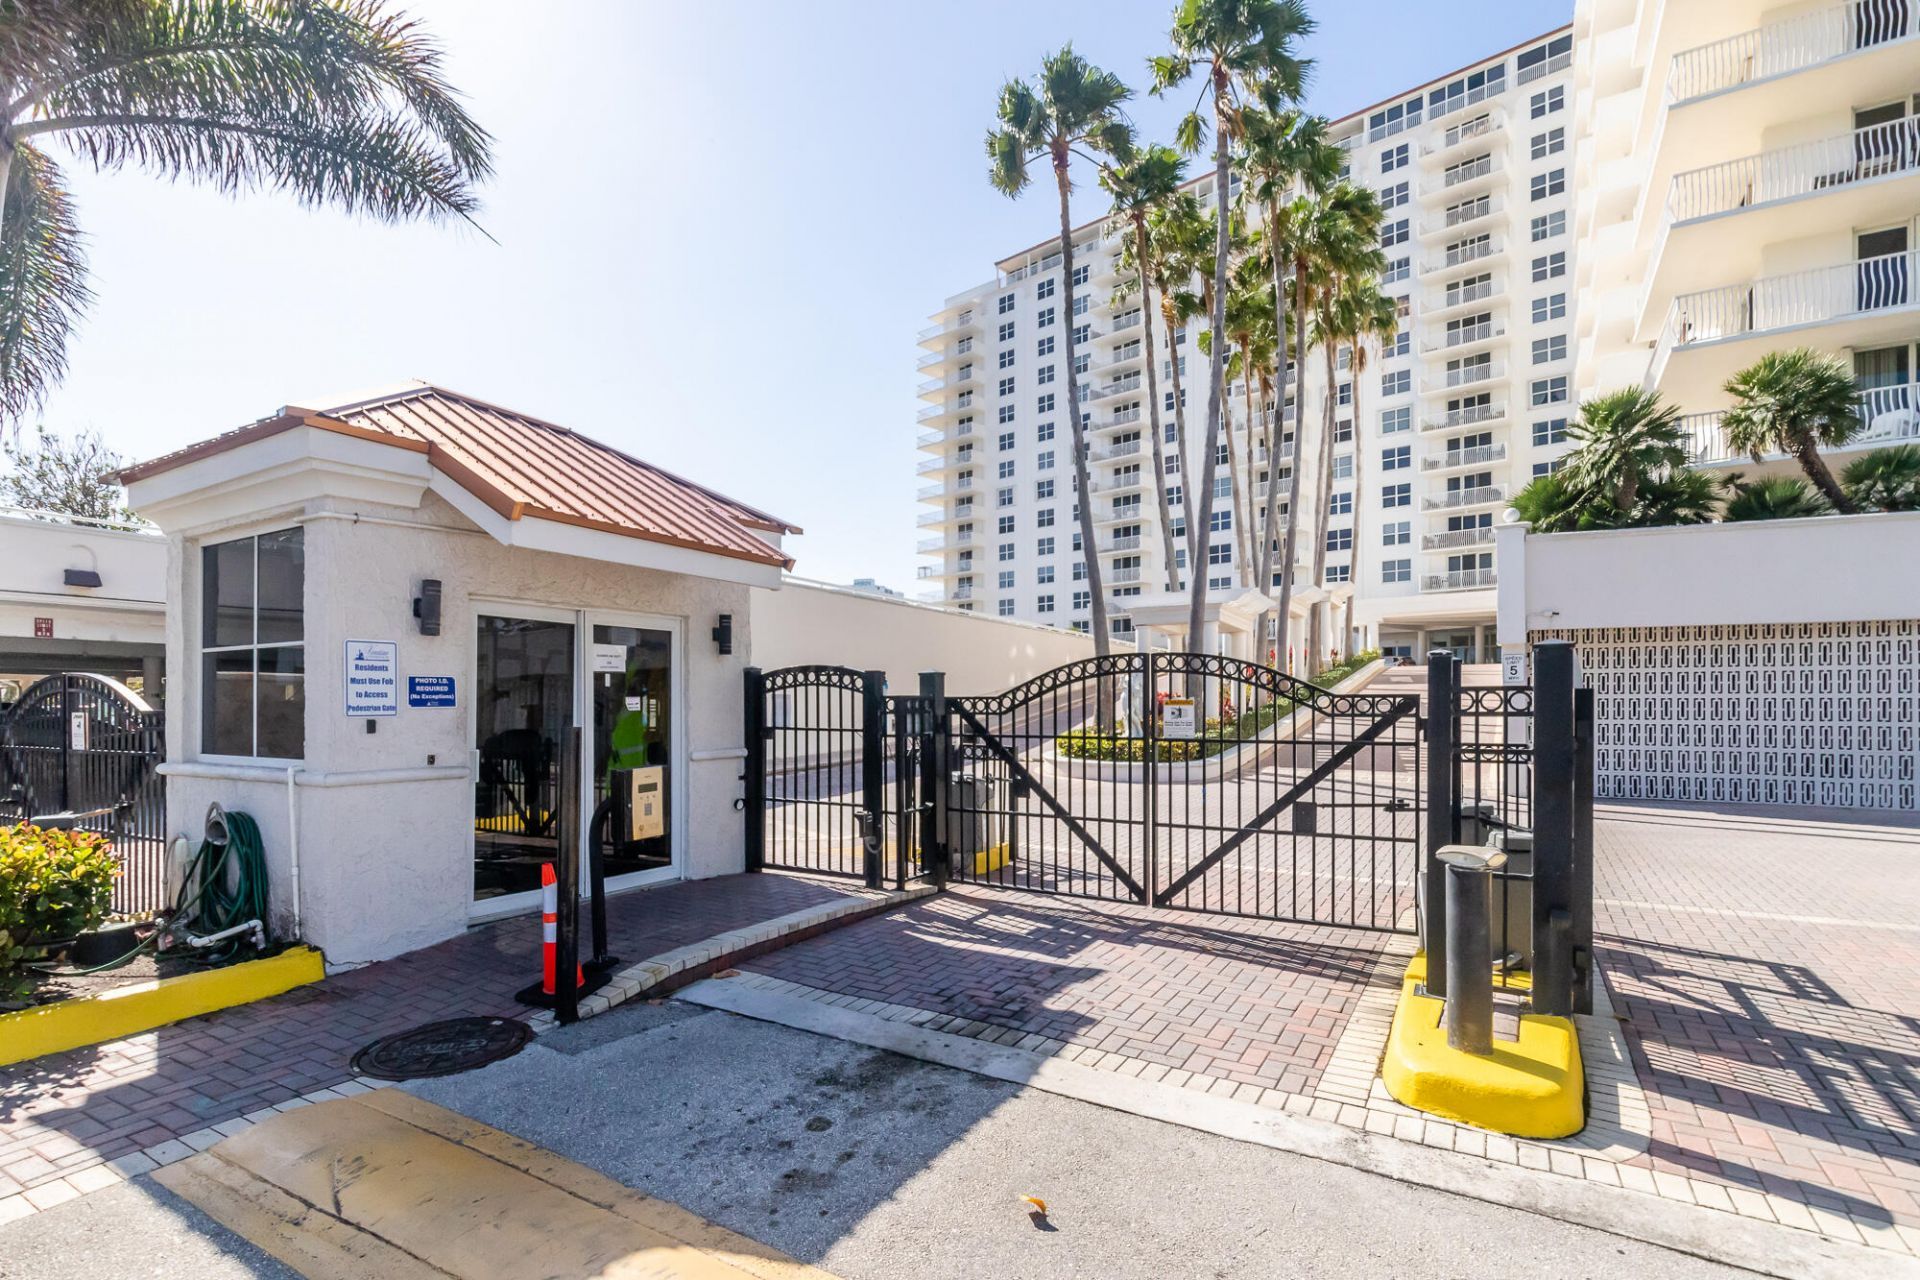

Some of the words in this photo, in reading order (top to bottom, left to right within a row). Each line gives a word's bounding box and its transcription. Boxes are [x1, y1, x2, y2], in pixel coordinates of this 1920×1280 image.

[355, 664, 388, 672] Residents
[1510, 665, 1518, 676] 5
[350, 677, 367, 685] Must
[368, 677, 381, 685] Use
[382, 677, 394, 686] Fob
[364, 691, 388, 699] Access
[347, 704, 381, 712] Pedestrian
